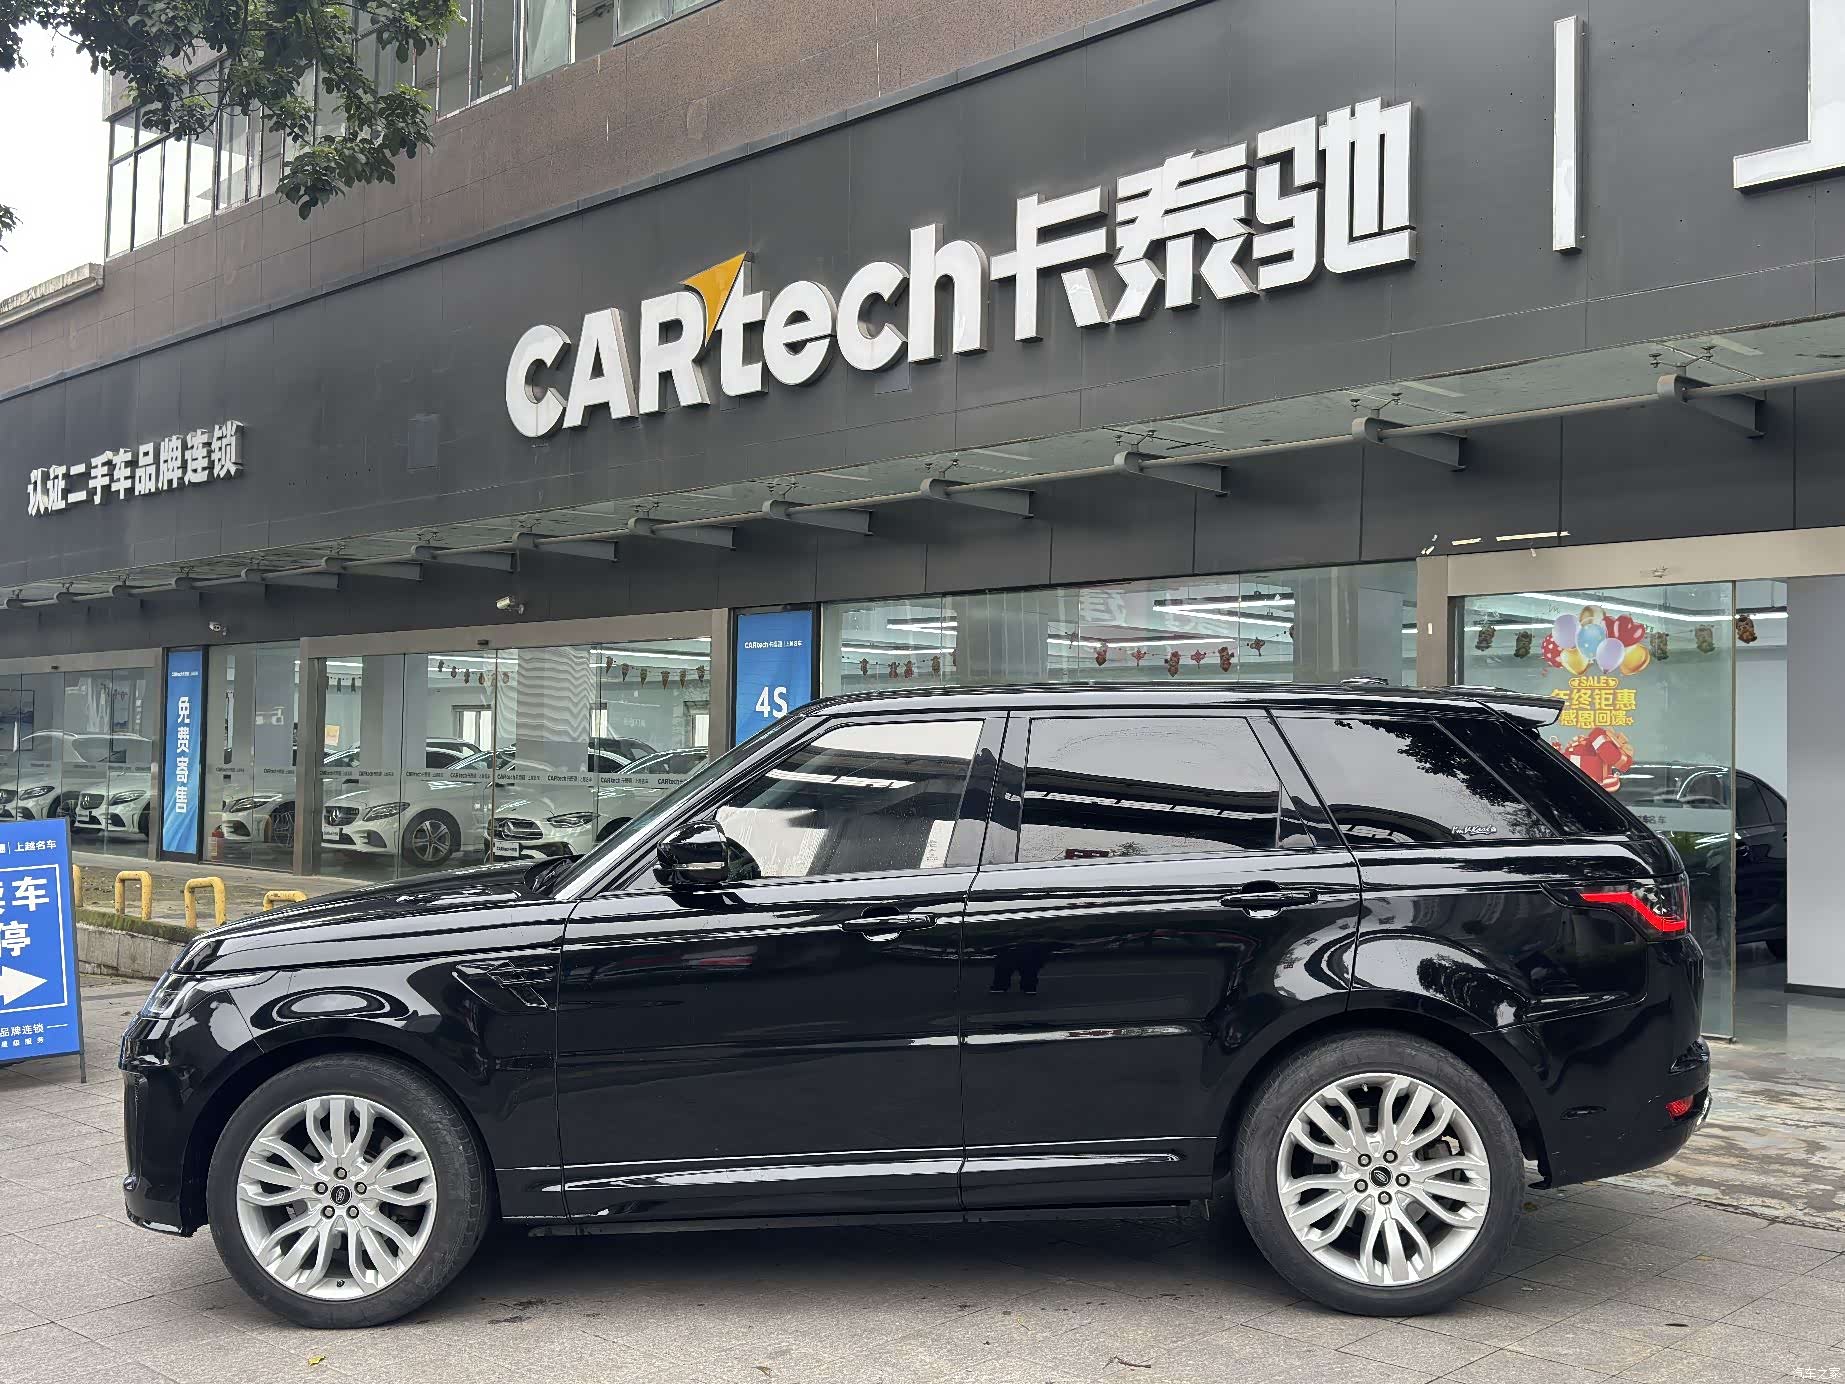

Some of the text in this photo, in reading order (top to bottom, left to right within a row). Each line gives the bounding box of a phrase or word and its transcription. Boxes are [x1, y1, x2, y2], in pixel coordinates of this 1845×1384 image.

[505, 97, 1416, 440] CARtech 卡泰驰
[26, 420, 245, 516] 认证二手车品牌连锁
[1579, 675, 1607, 687] SALE
[755, 686, 788, 718] 4S
[1551, 688, 1637, 711] 年终钜惠
[1560, 709, 1627, 728] 感恩回馈
[175, 696, 191, 813] 免费寄售
[0, 1023, 44, 1037] 品牌连锁
